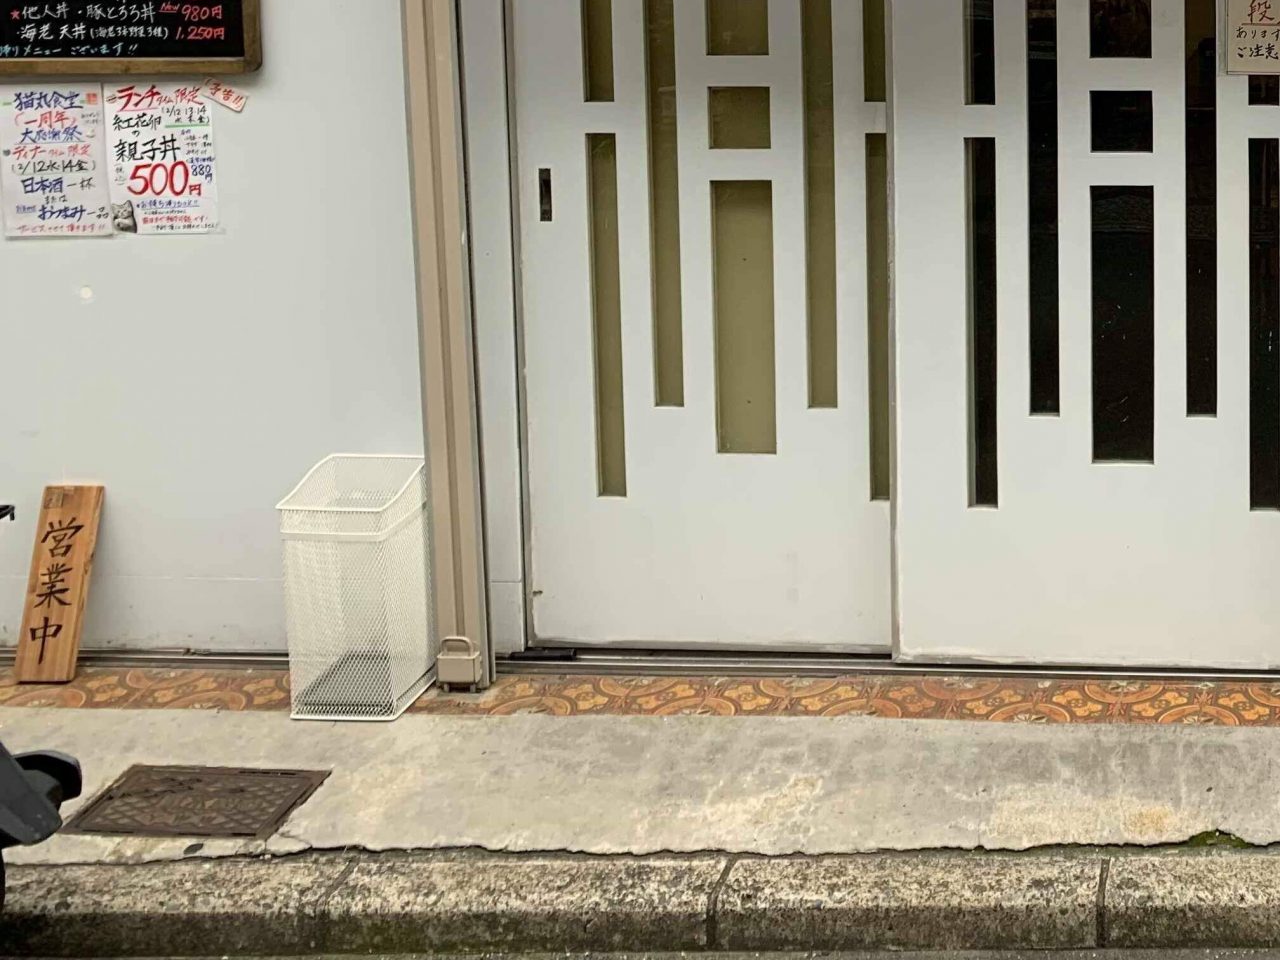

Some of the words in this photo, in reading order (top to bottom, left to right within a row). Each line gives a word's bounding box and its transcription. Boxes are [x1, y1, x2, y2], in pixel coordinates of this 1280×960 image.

[181, 4, 223, 21] 980円
[114, 134, 181, 162] 親子丼
[30, 517, 84, 665] 営業中
